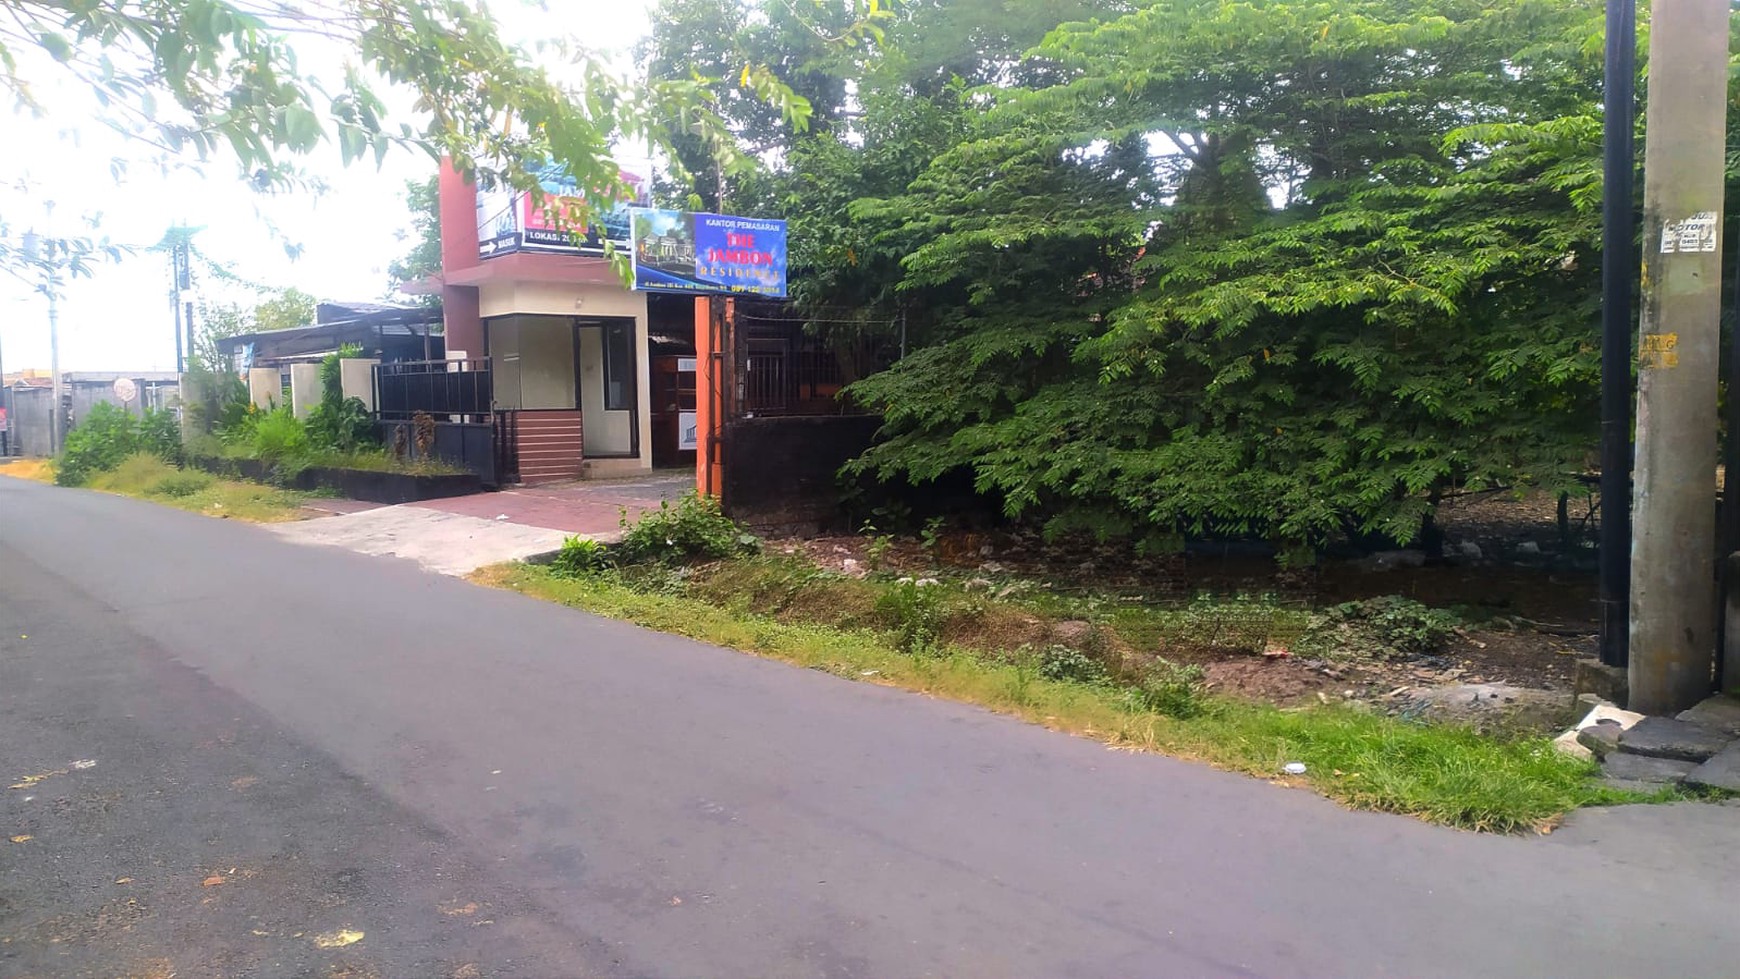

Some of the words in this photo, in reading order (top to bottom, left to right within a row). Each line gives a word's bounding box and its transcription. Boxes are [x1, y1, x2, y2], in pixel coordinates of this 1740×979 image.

[705, 219, 736, 229] KANTOR
[736, 221, 780, 232] PEMASARAN
[1668, 223, 1706, 232] MOTOR
[727, 233, 755, 248] THE
[708, 248, 773, 267] JAMBON
